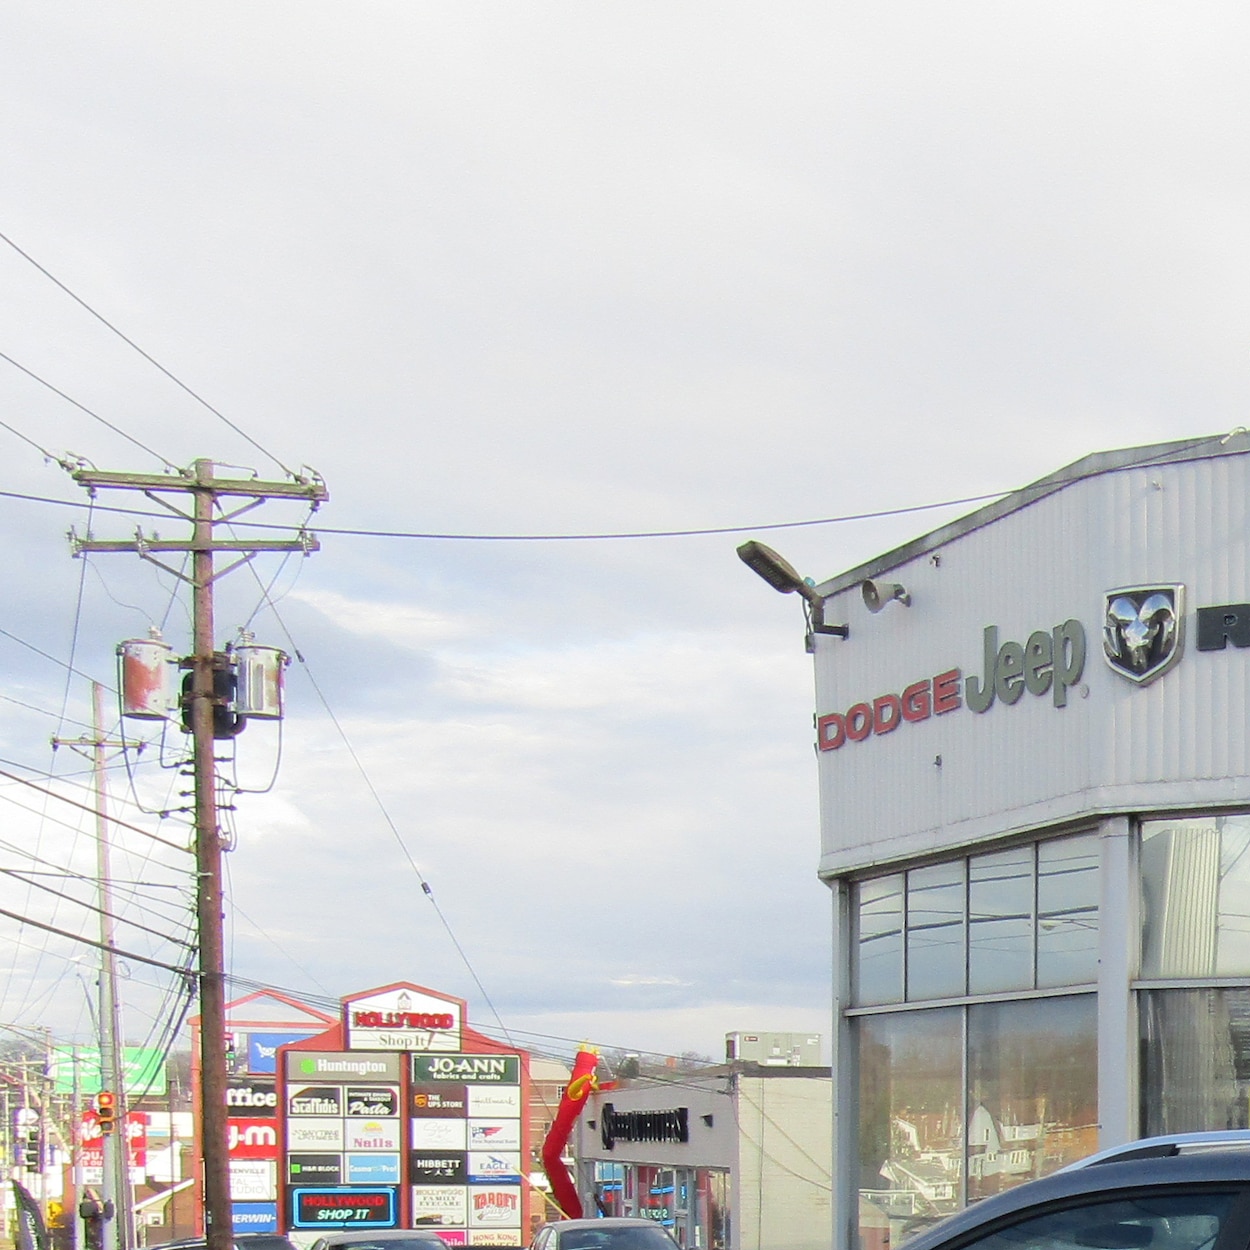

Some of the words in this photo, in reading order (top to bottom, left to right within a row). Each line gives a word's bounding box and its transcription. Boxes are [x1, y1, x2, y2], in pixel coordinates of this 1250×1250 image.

[965, 619, 1087, 714] Jeep
[818, 667, 962, 751] DODGE
[379, 1035, 412, 1051] Shop
[317, 1059, 387, 1075] Huntington
[428, 1058, 506, 1073] JO-ANN
[433, 1072, 460, 1080] fabrics
[461, 1072, 477, 1080] and
[226, 1088, 278, 1107] ffice
[349, 1101, 392, 1115] Pasta
[353, 1138, 393, 1148] Nails
[417, 1160, 461, 1168] HIBBETT
[303, 1196, 385, 1207] HOLLYWOOD
[317, 1209, 354, 1220] SHOP
[443, 1237, 464, 1246] bile
[473, 1234, 496, 1242] HONG
[497, 1233, 518, 1242] KONG
